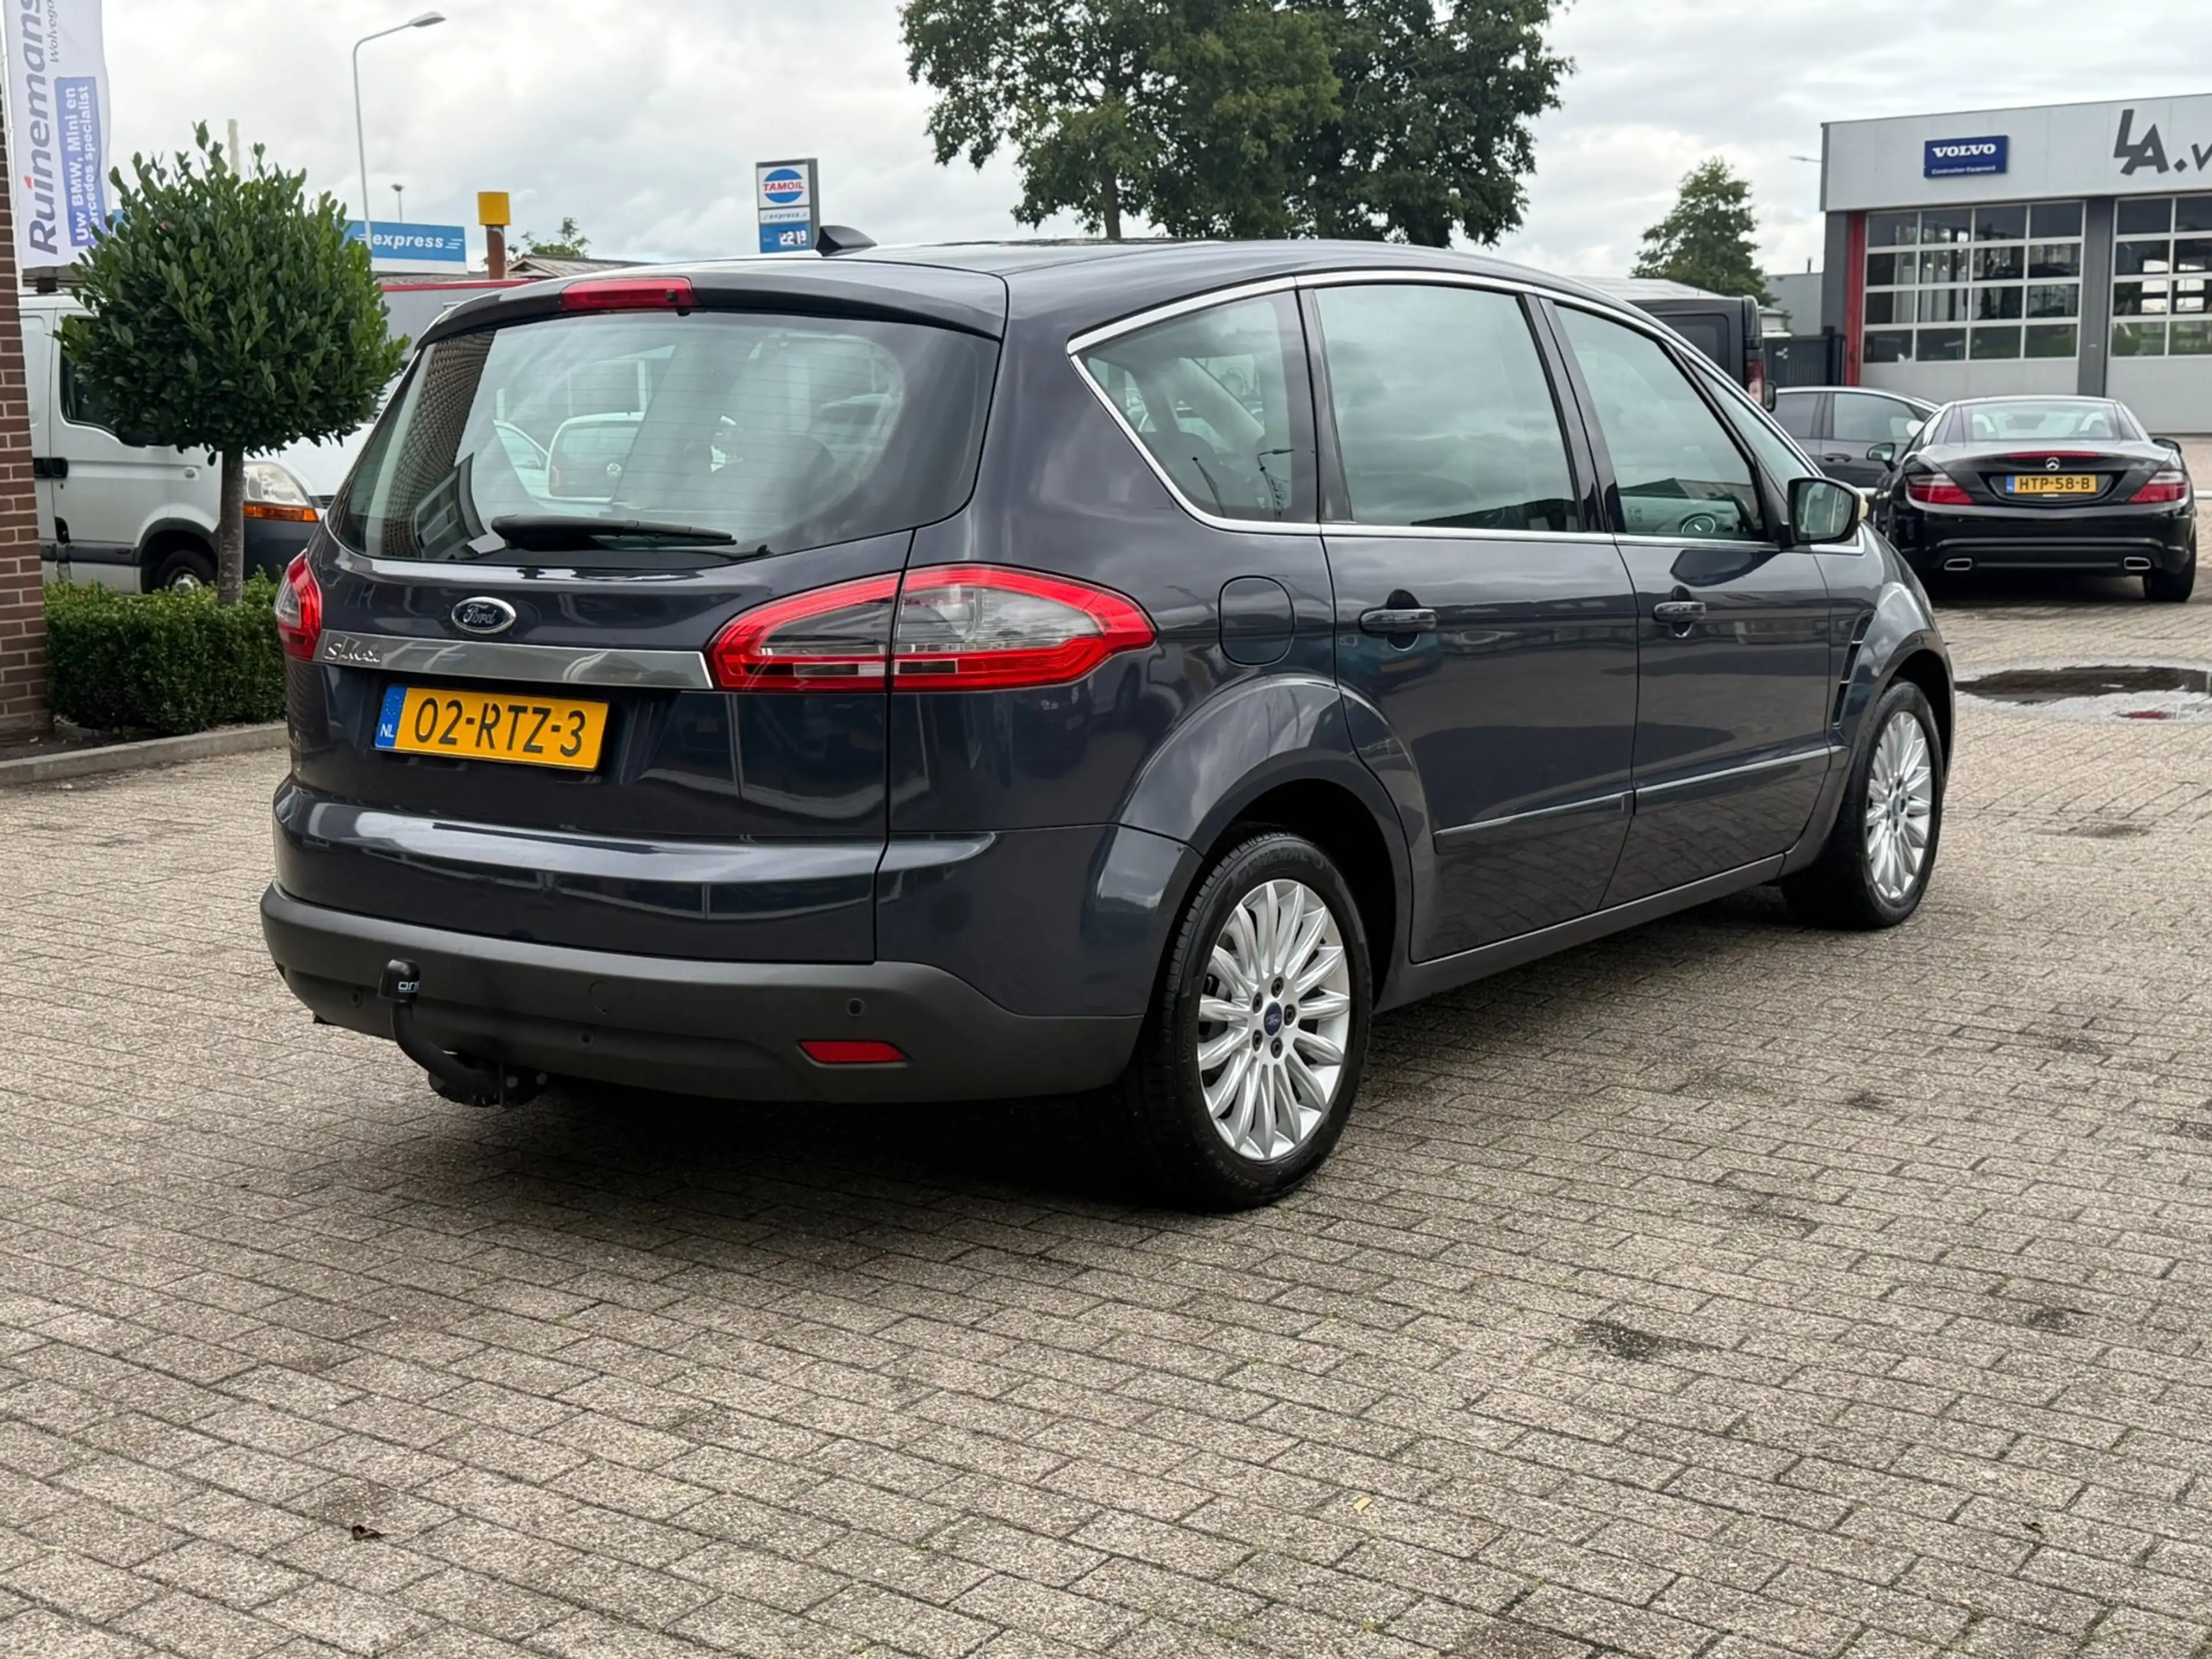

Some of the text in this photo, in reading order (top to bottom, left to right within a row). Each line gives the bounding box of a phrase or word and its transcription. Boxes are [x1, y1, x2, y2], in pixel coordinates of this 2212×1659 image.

[1932, 143, 1997, 158] VOLVO
[65, 87, 88, 241] Uw BMW, Mini en
[77, 85, 100, 240] ercedes specialist
[763, 181, 804, 191] TAMOIL
[372, 234, 444, 249] express
[2019, 477, 2090, 490] HTP-58-B
[463, 603, 497, 625] Ford
[380, 724, 395, 739] NL
[414, 697, 586, 757] 02-RTZ-3
